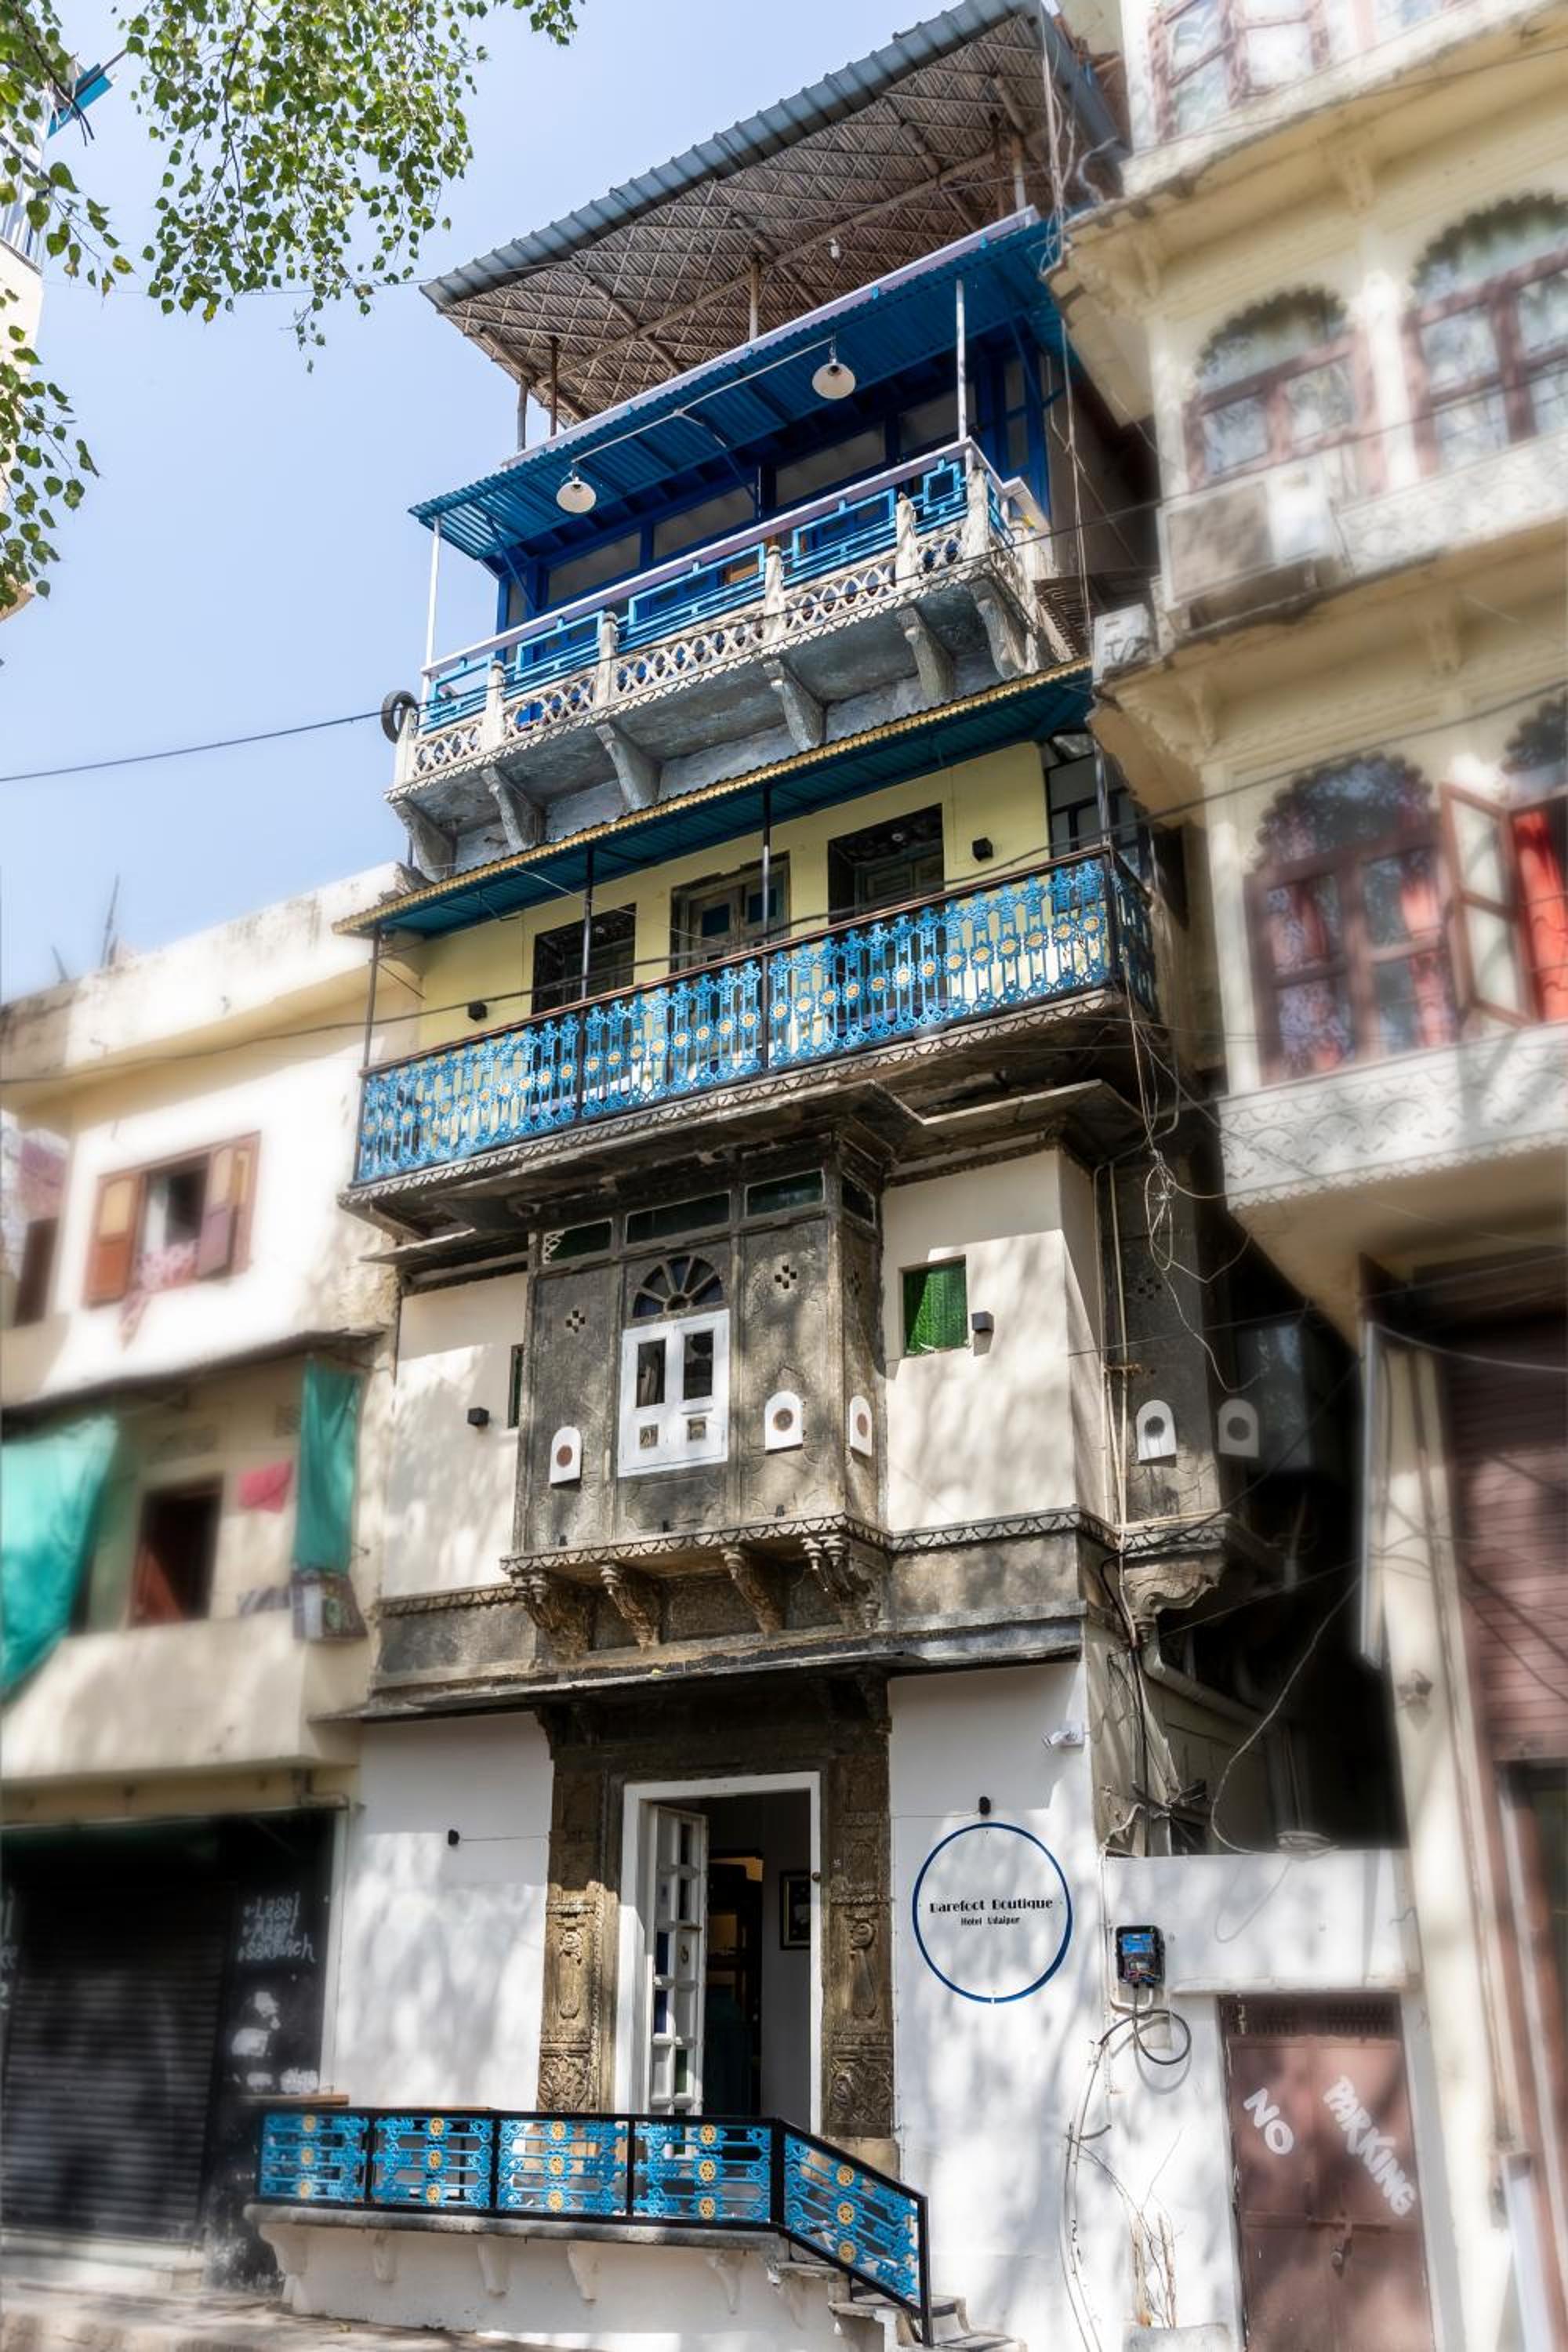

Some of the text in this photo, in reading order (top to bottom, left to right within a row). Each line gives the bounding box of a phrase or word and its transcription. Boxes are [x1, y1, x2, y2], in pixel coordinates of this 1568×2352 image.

[929, 1898, 1053, 1913] Barefoot Boutique
[960, 1915, 1021, 1926] Hotel Udaipur
[1243, 2075, 1417, 2216] NO PARKING
